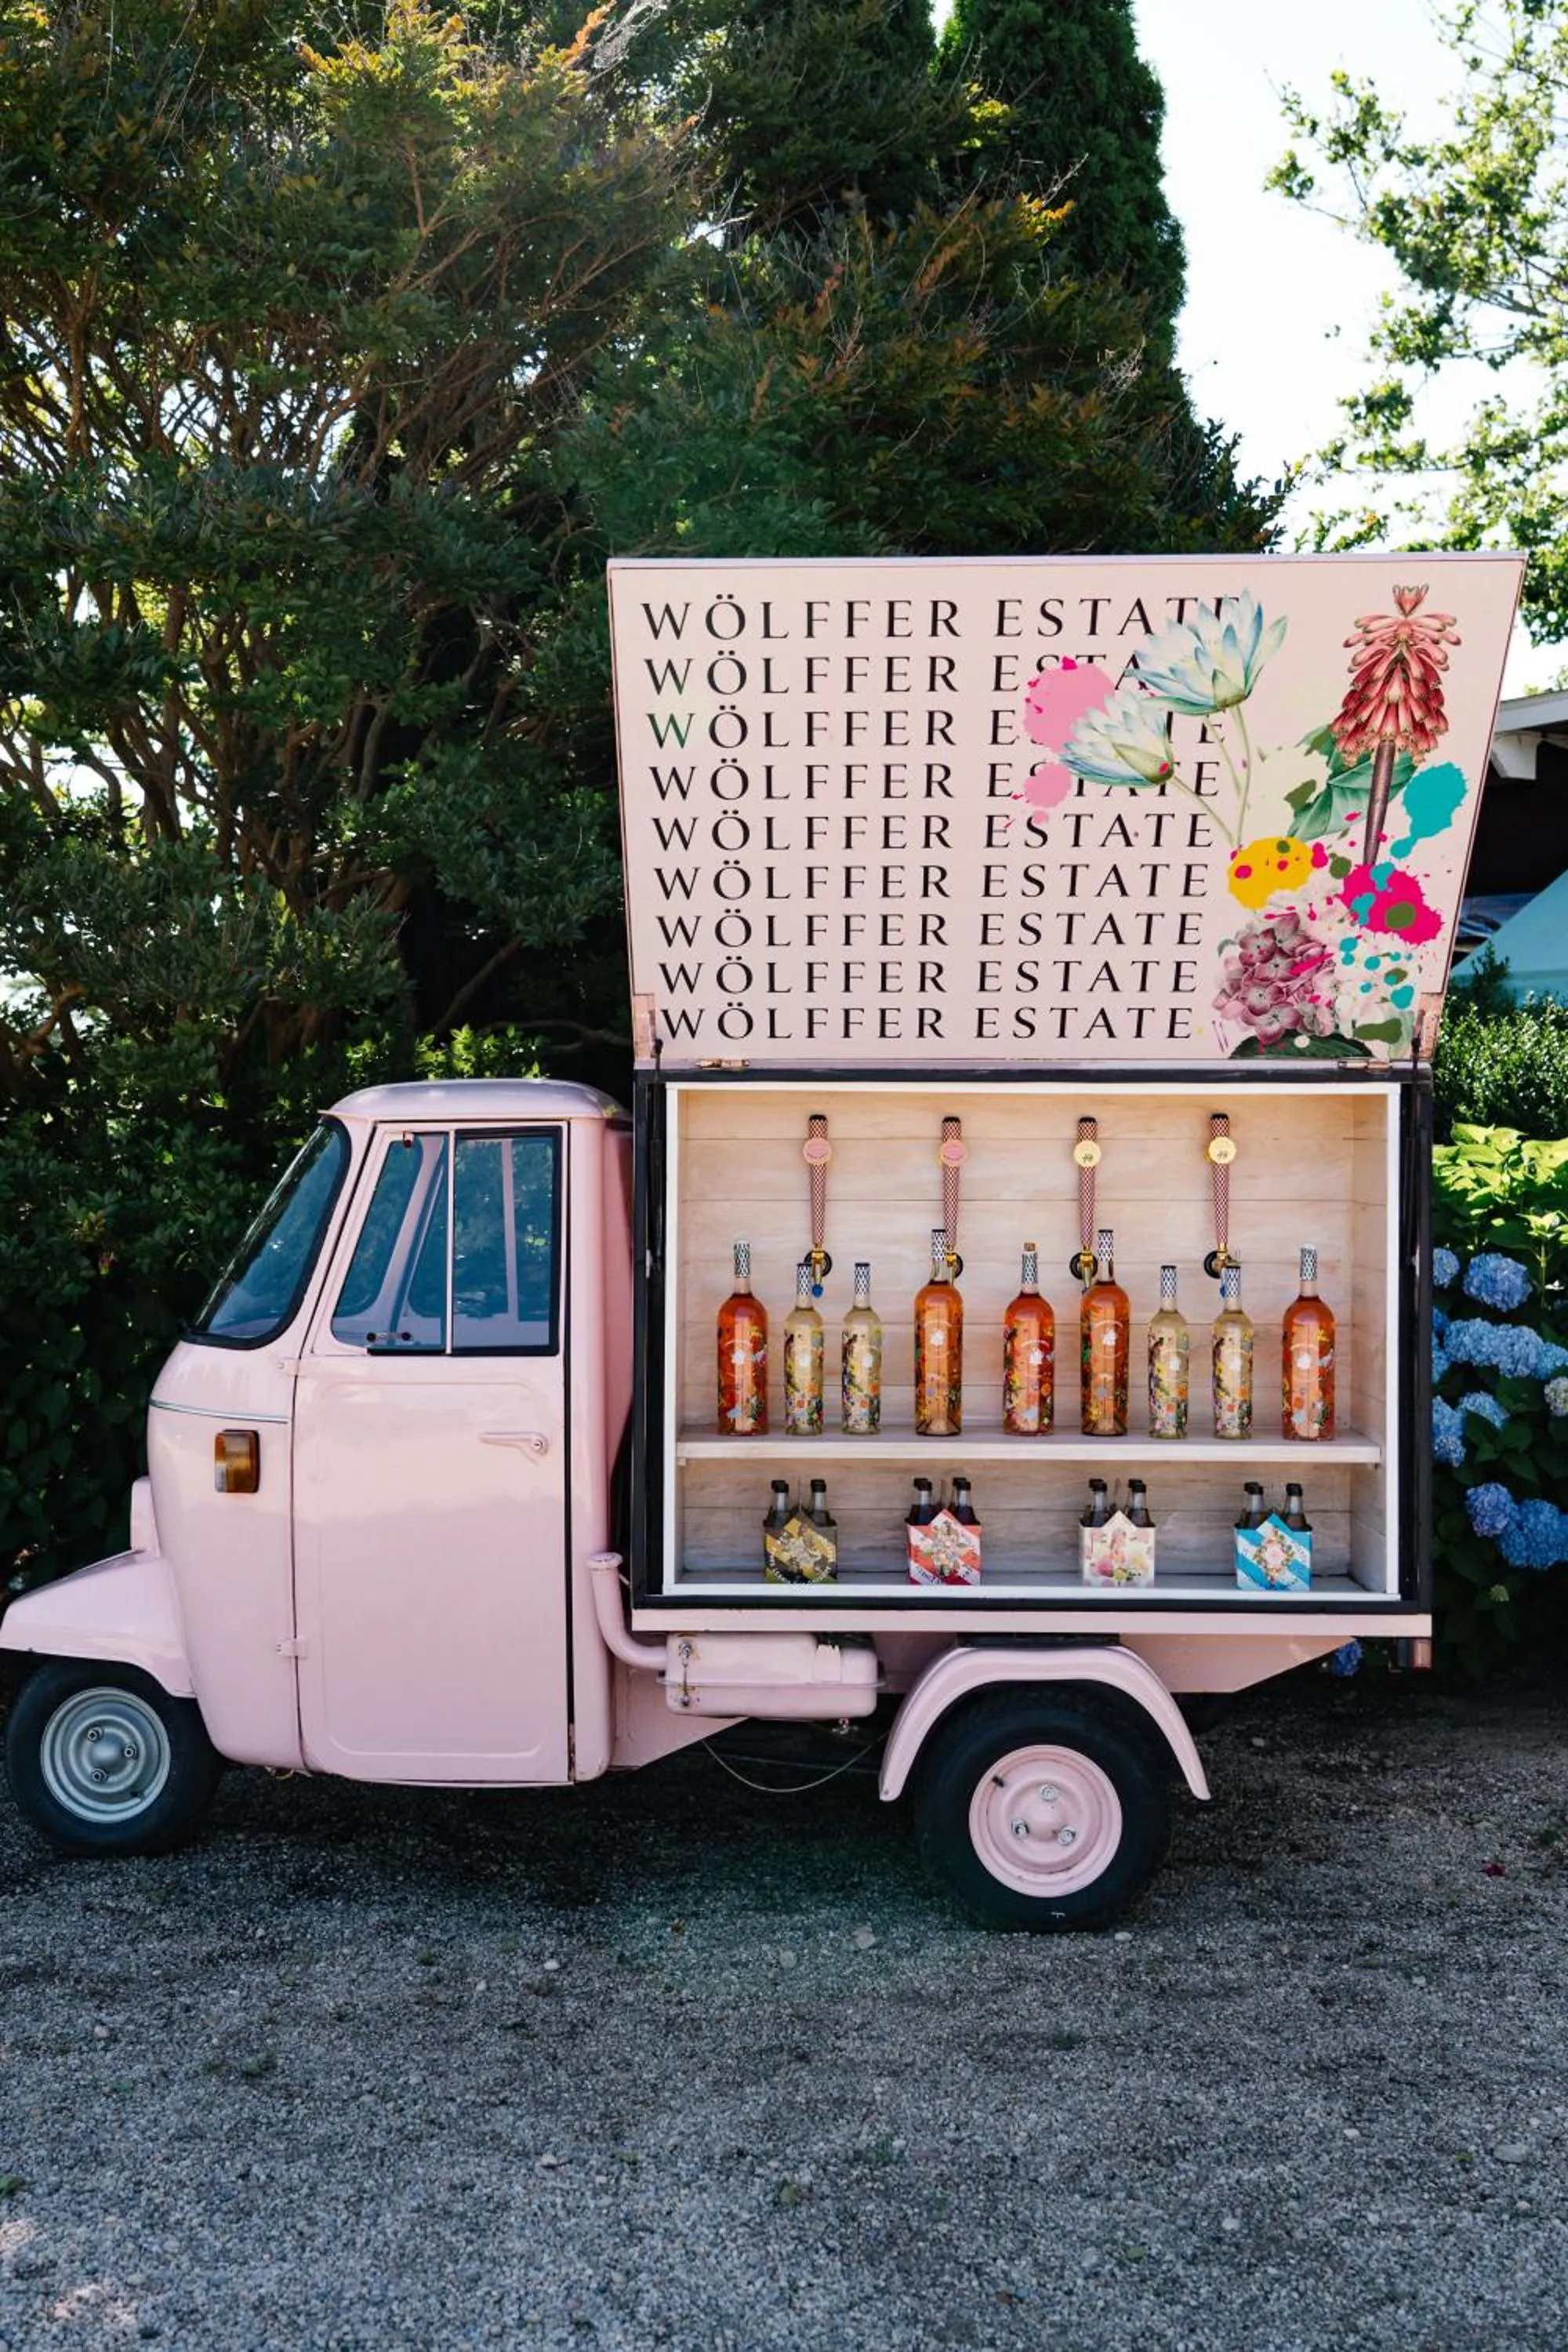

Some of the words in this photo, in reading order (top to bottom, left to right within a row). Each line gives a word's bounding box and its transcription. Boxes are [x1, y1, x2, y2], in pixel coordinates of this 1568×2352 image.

[641, 593, 961, 641] WÖLFFER
[644, 650, 959, 695] WÖLFFER
[645, 704, 956, 750] WÖLFFER
[648, 757, 954, 801] WÖLFFER
[652, 809, 953, 851] WÖLFFER
[984, 812, 1213, 849] ESTATE
[653, 859, 950, 901] WÖLFFER
[981, 862, 1208, 898] ESTATE
[655, 908, 949, 948] WÖLFFER
[979, 912, 1203, 946] ESTATE
[658, 955, 948, 995] WÖLFFER
[977, 959, 1197, 993] ESTATE
[661, 1001, 946, 1040] WÖLFFER
[975, 1006, 1192, 1040] ESTATE
